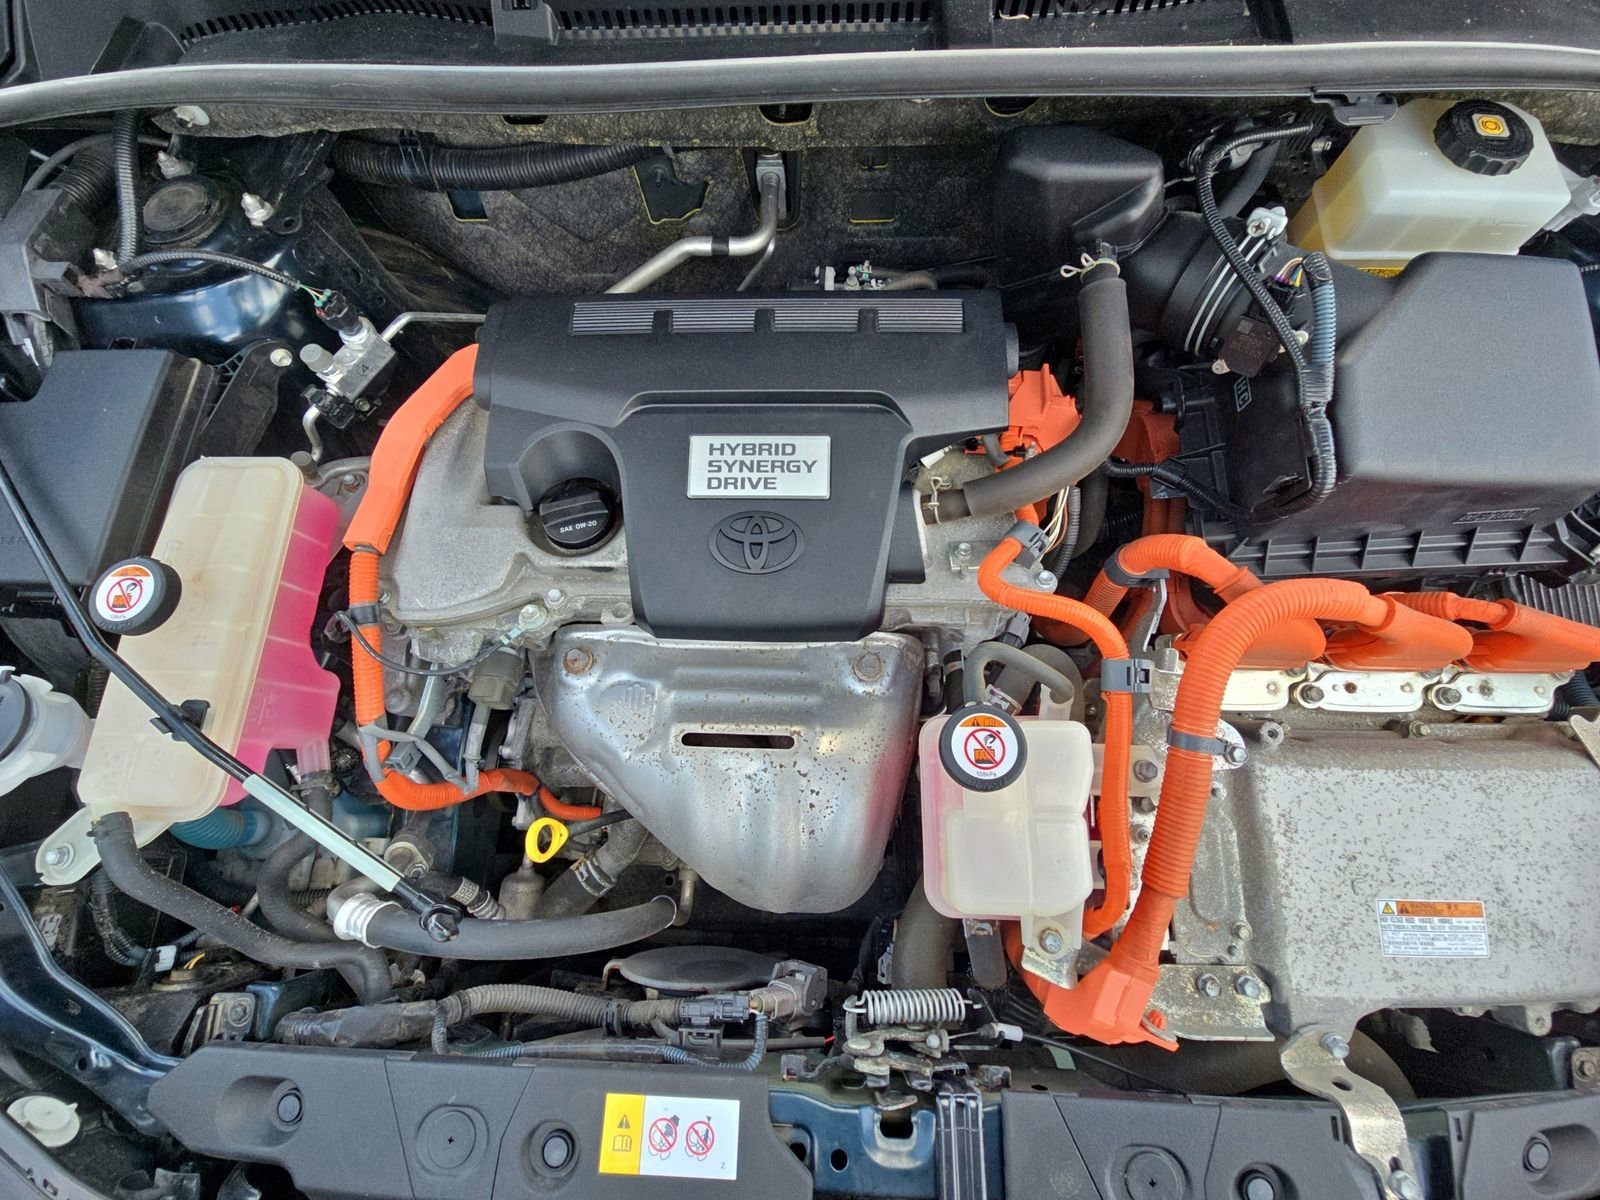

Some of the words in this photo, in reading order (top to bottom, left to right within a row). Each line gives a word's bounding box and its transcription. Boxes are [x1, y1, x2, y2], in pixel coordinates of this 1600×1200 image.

[709, 443, 796, 456] HYBRID
[708, 460, 817, 473] SYNERGY
[707, 477, 777, 490] DRIVE
[560, 525, 573, 533] SAE
[575, 520, 597, 530] 0W-20
